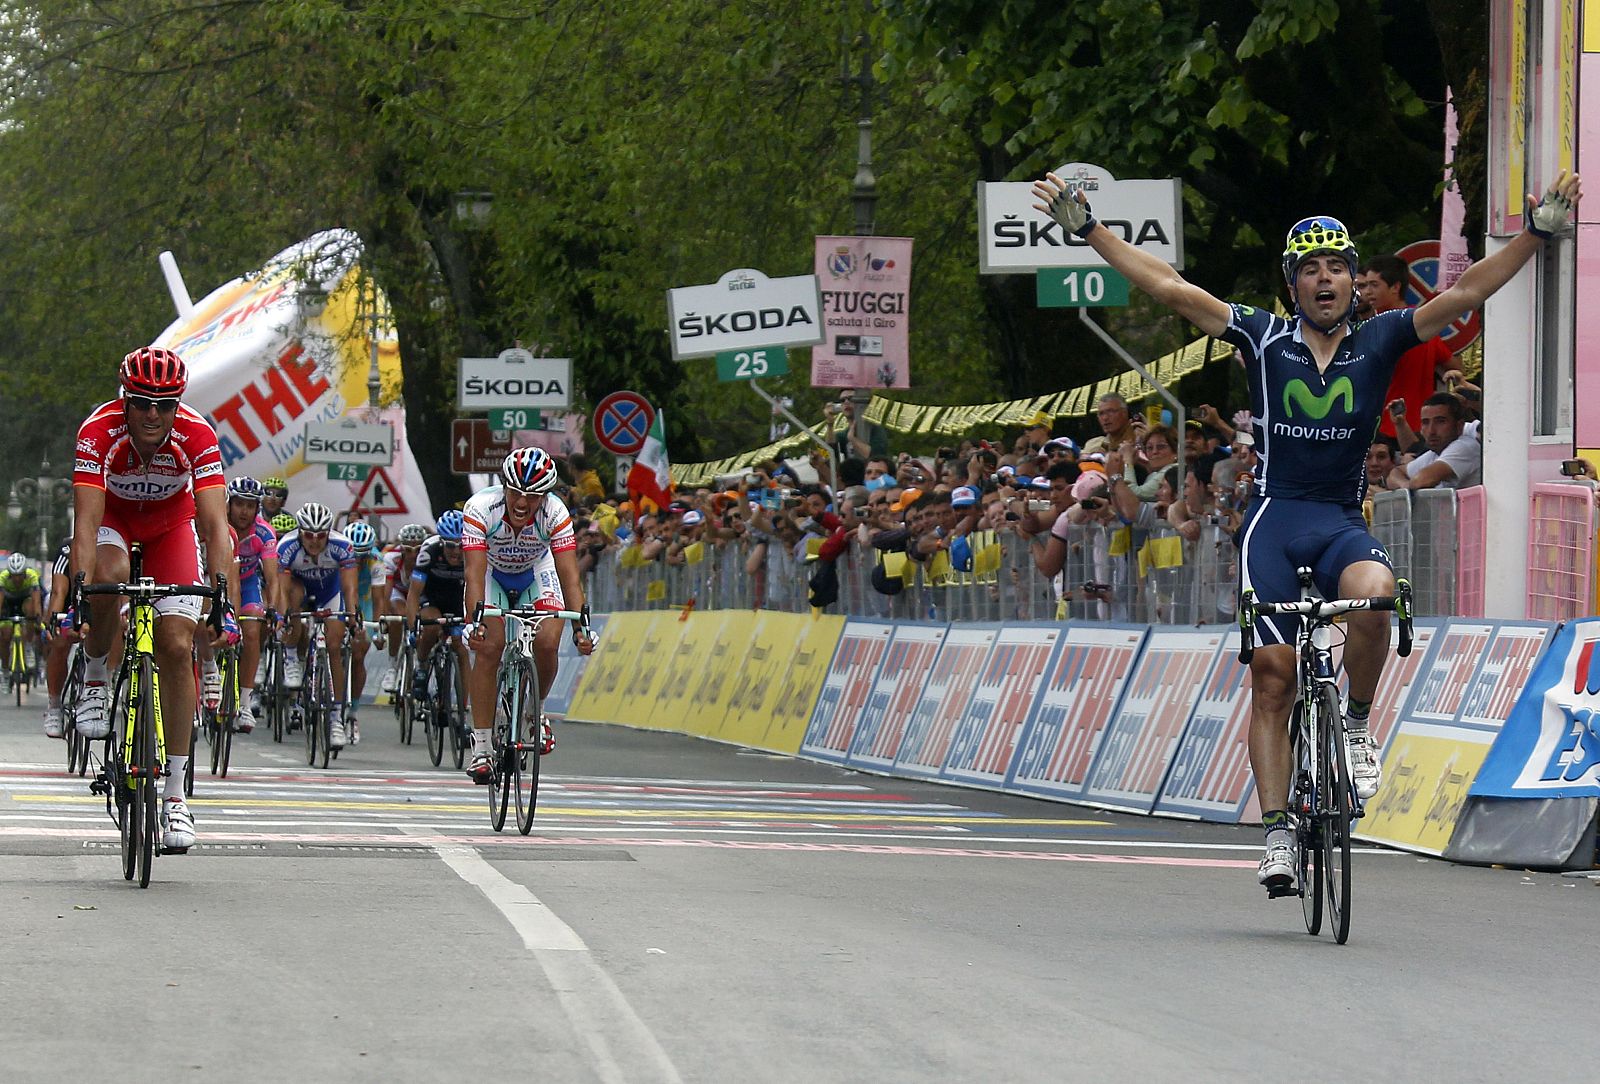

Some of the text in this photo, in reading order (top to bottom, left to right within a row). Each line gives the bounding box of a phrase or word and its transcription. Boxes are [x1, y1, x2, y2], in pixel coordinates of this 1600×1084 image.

[1063, 271, 1105, 303] 10
[821, 290, 905, 314] FIUGGI
[679, 304, 813, 338] ŠKODA
[827, 317, 862, 327] saluta
[874, 317, 896, 328] Giro
[734, 351, 768, 377] 25
[465, 376, 564, 395] ŠKODA
[503, 410, 527, 428] 50
[1274, 422, 1356, 441] movistar
[309, 436, 386, 454] ŠKODA
[338, 465, 357, 479] 75
